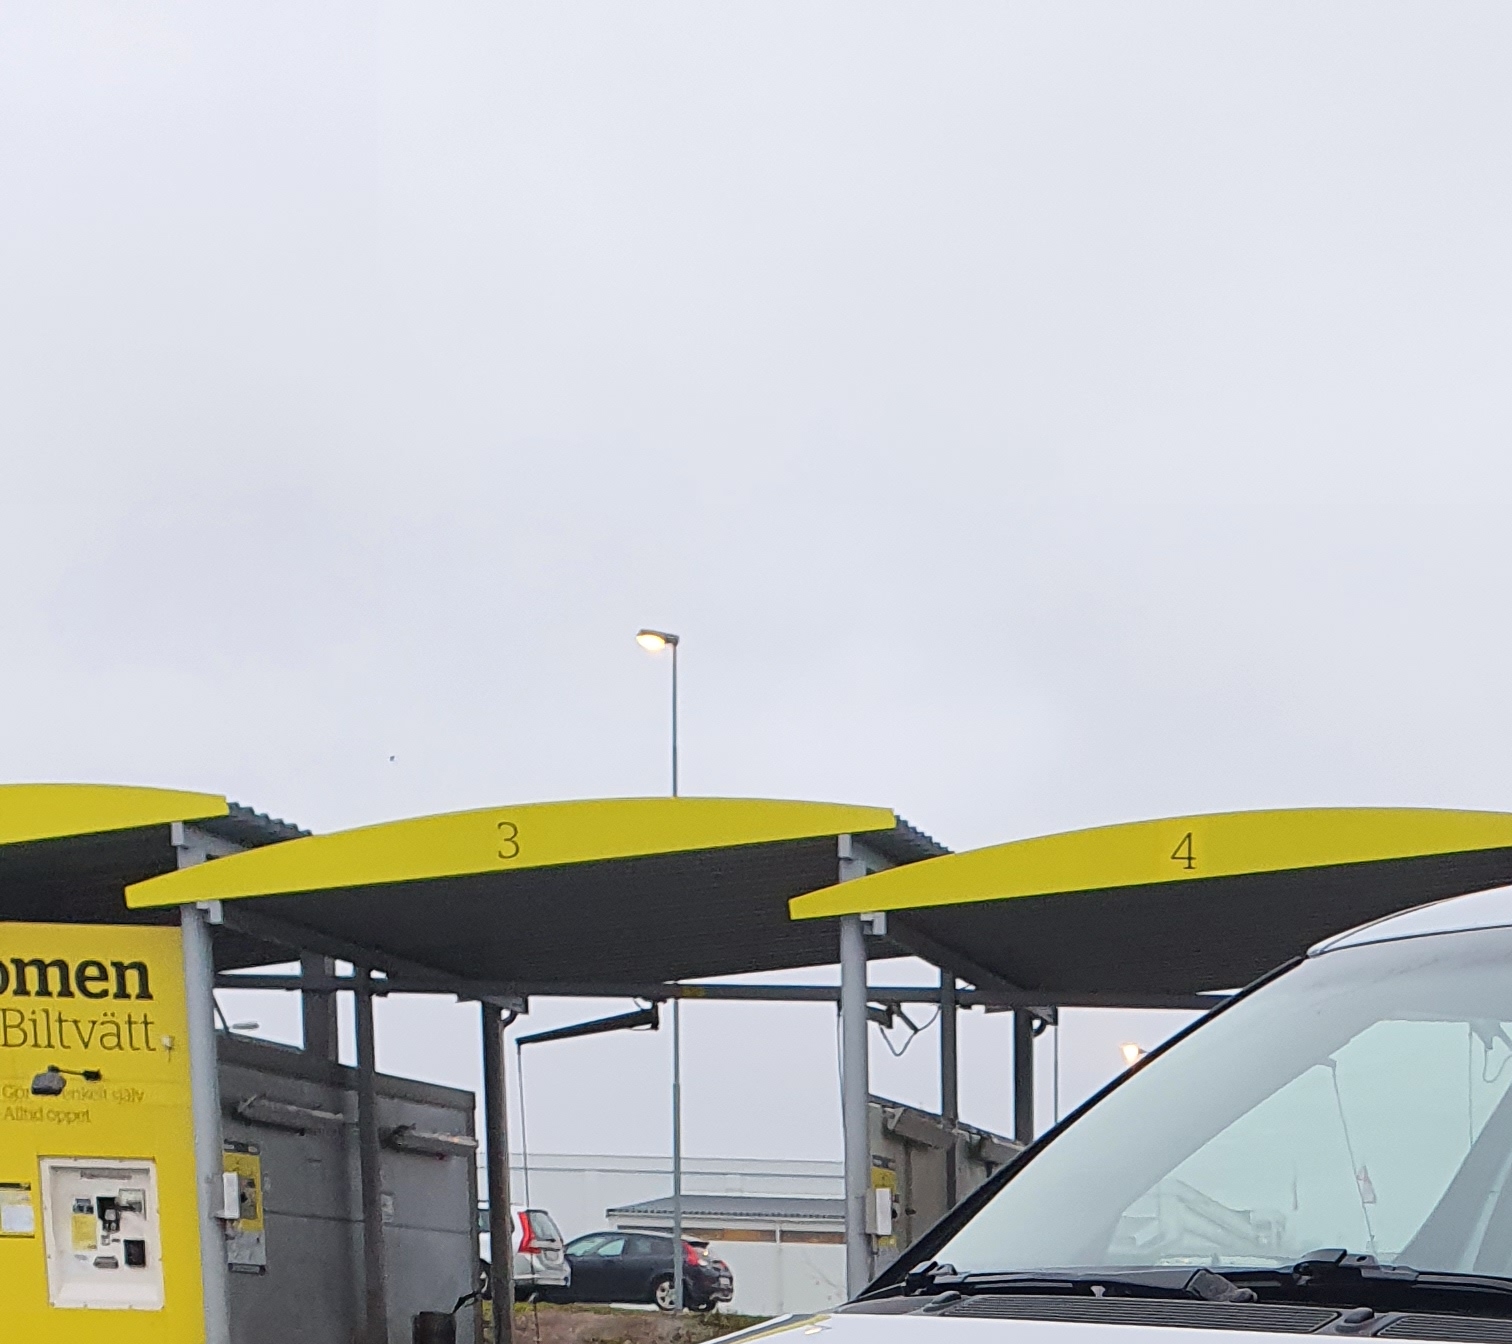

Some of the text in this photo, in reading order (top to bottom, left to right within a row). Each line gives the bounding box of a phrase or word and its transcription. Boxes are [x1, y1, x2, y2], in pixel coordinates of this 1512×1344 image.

[497, 821, 520, 859] 3
[1170, 832, 1197, 870] 4
[0, 957, 154, 1000] men
[0, 1007, 157, 1051] Biltvätt
